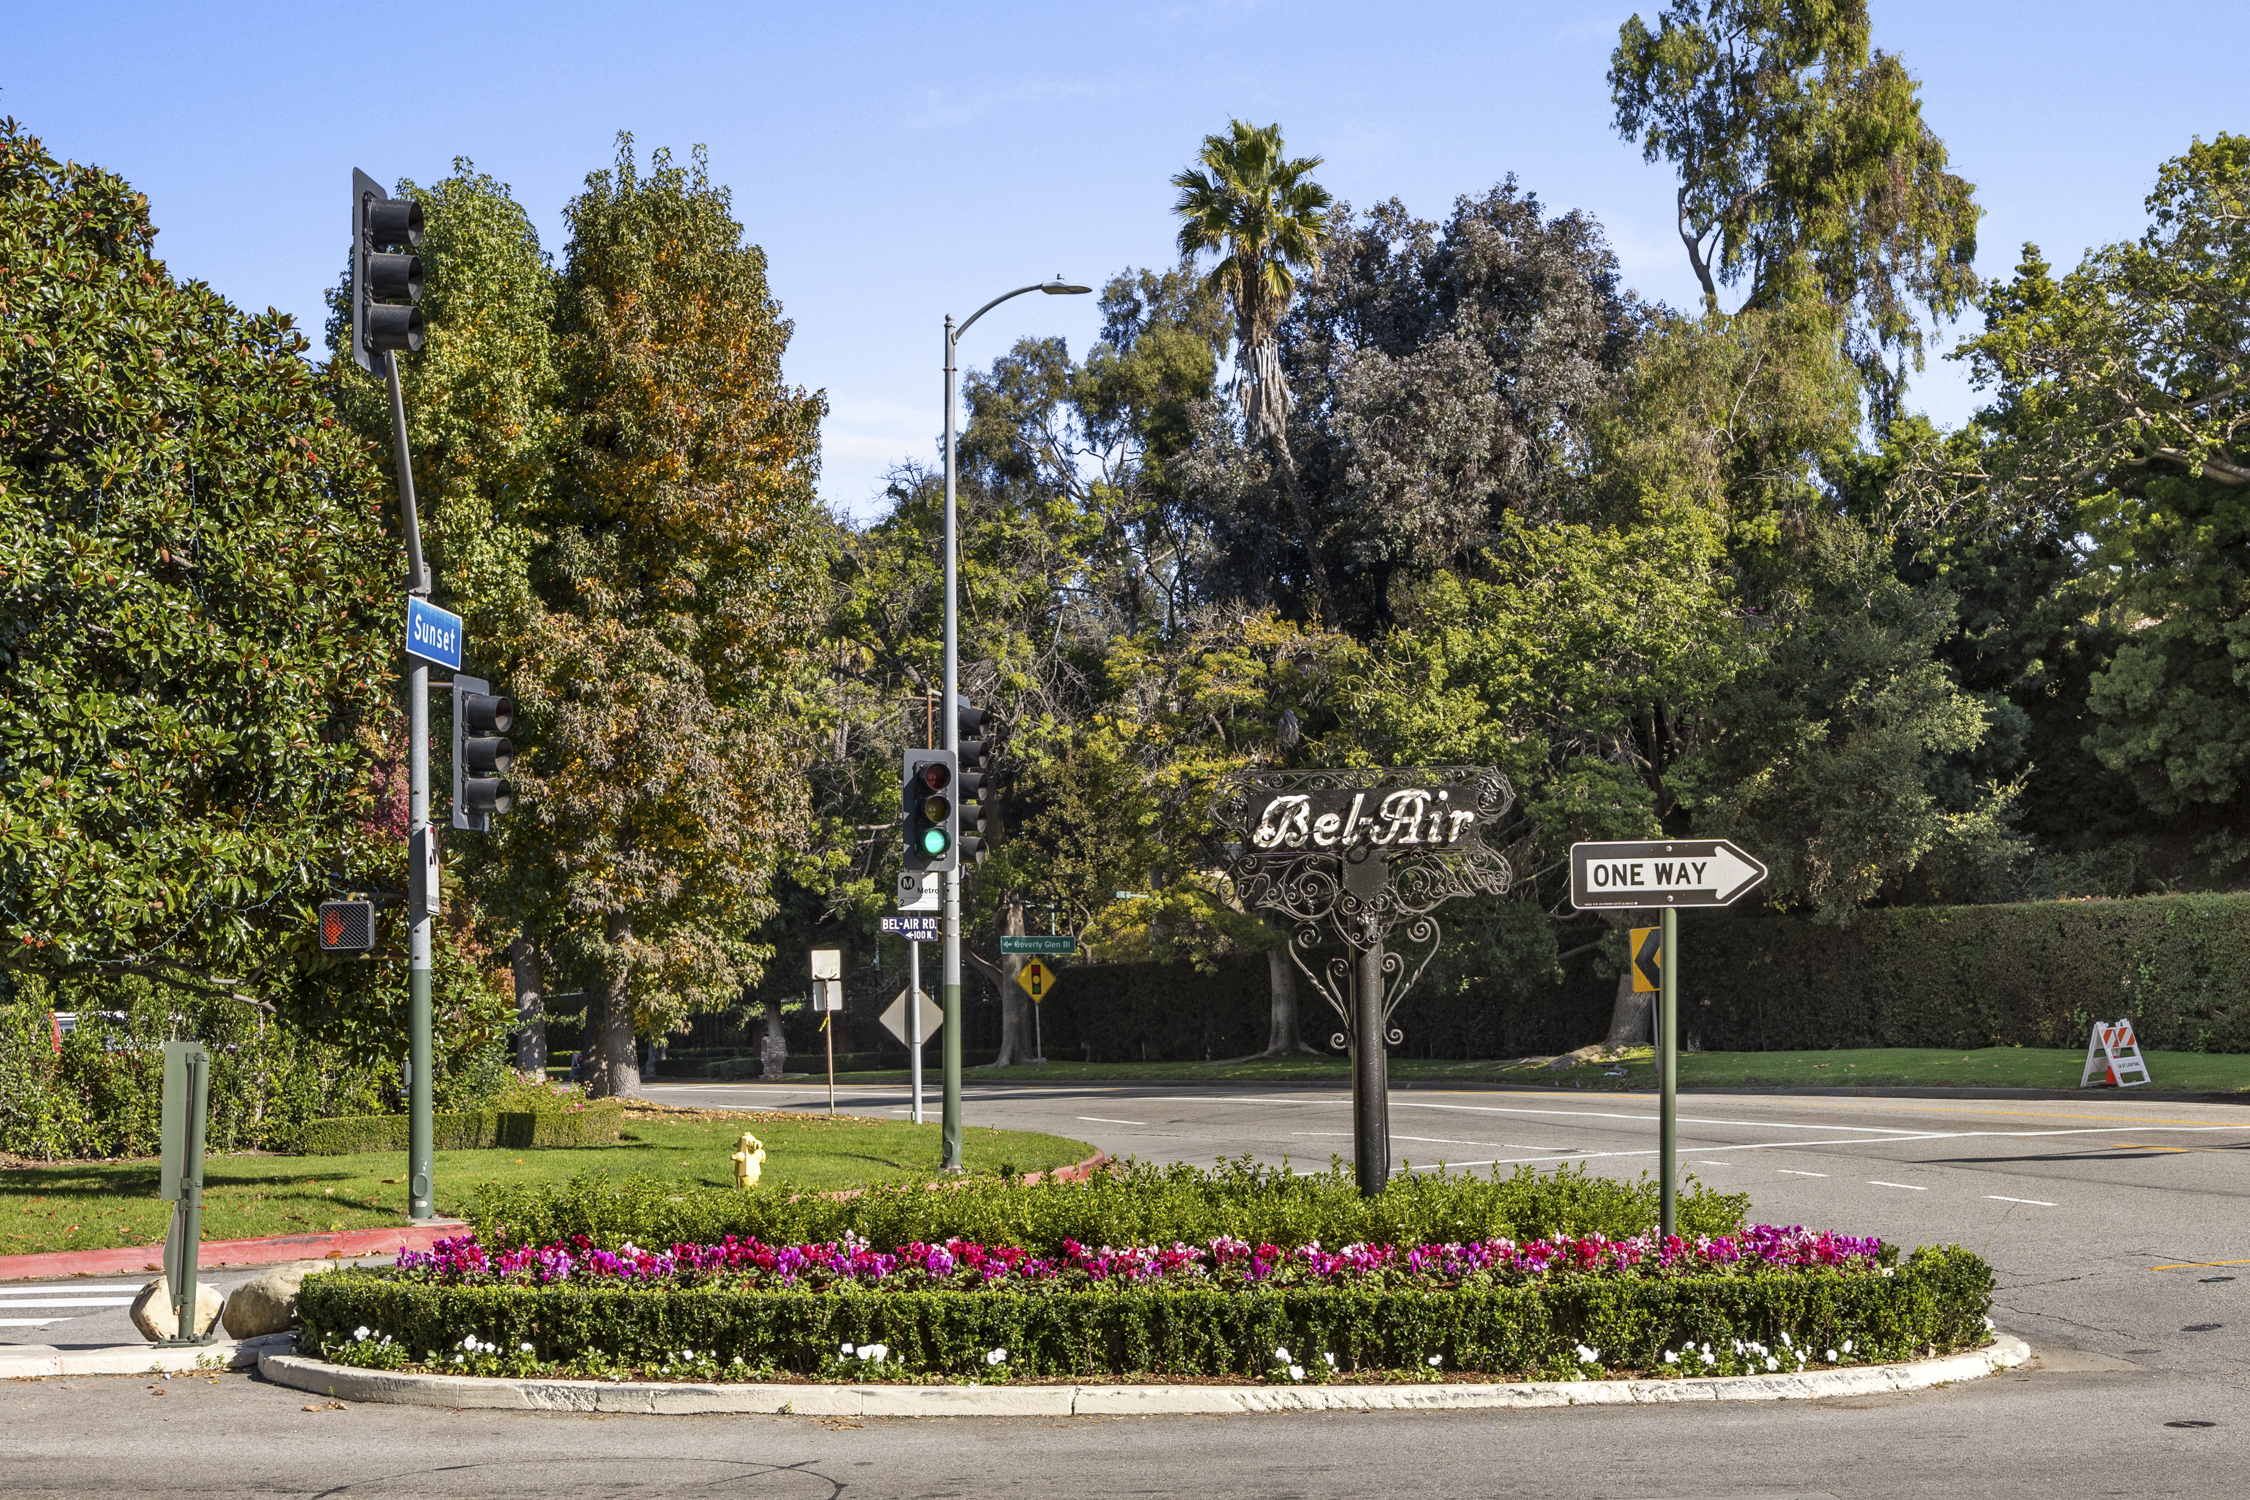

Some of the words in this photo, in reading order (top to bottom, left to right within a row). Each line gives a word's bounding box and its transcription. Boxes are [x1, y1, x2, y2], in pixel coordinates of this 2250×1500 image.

[414, 613, 455, 654] Sunset
[1593, 863, 1644, 887] ONE
[1654, 861, 1707, 886] WAY
[902, 877, 914, 889] M
[900, 898, 905, 907] 2
[882, 918, 919, 930] BEL-AIR
[922, 918, 937, 930] RD.
[913, 930, 926, 940] 100
[1014, 940, 1042, 949] Beverly
[1044, 940, 1061, 948] Glen
